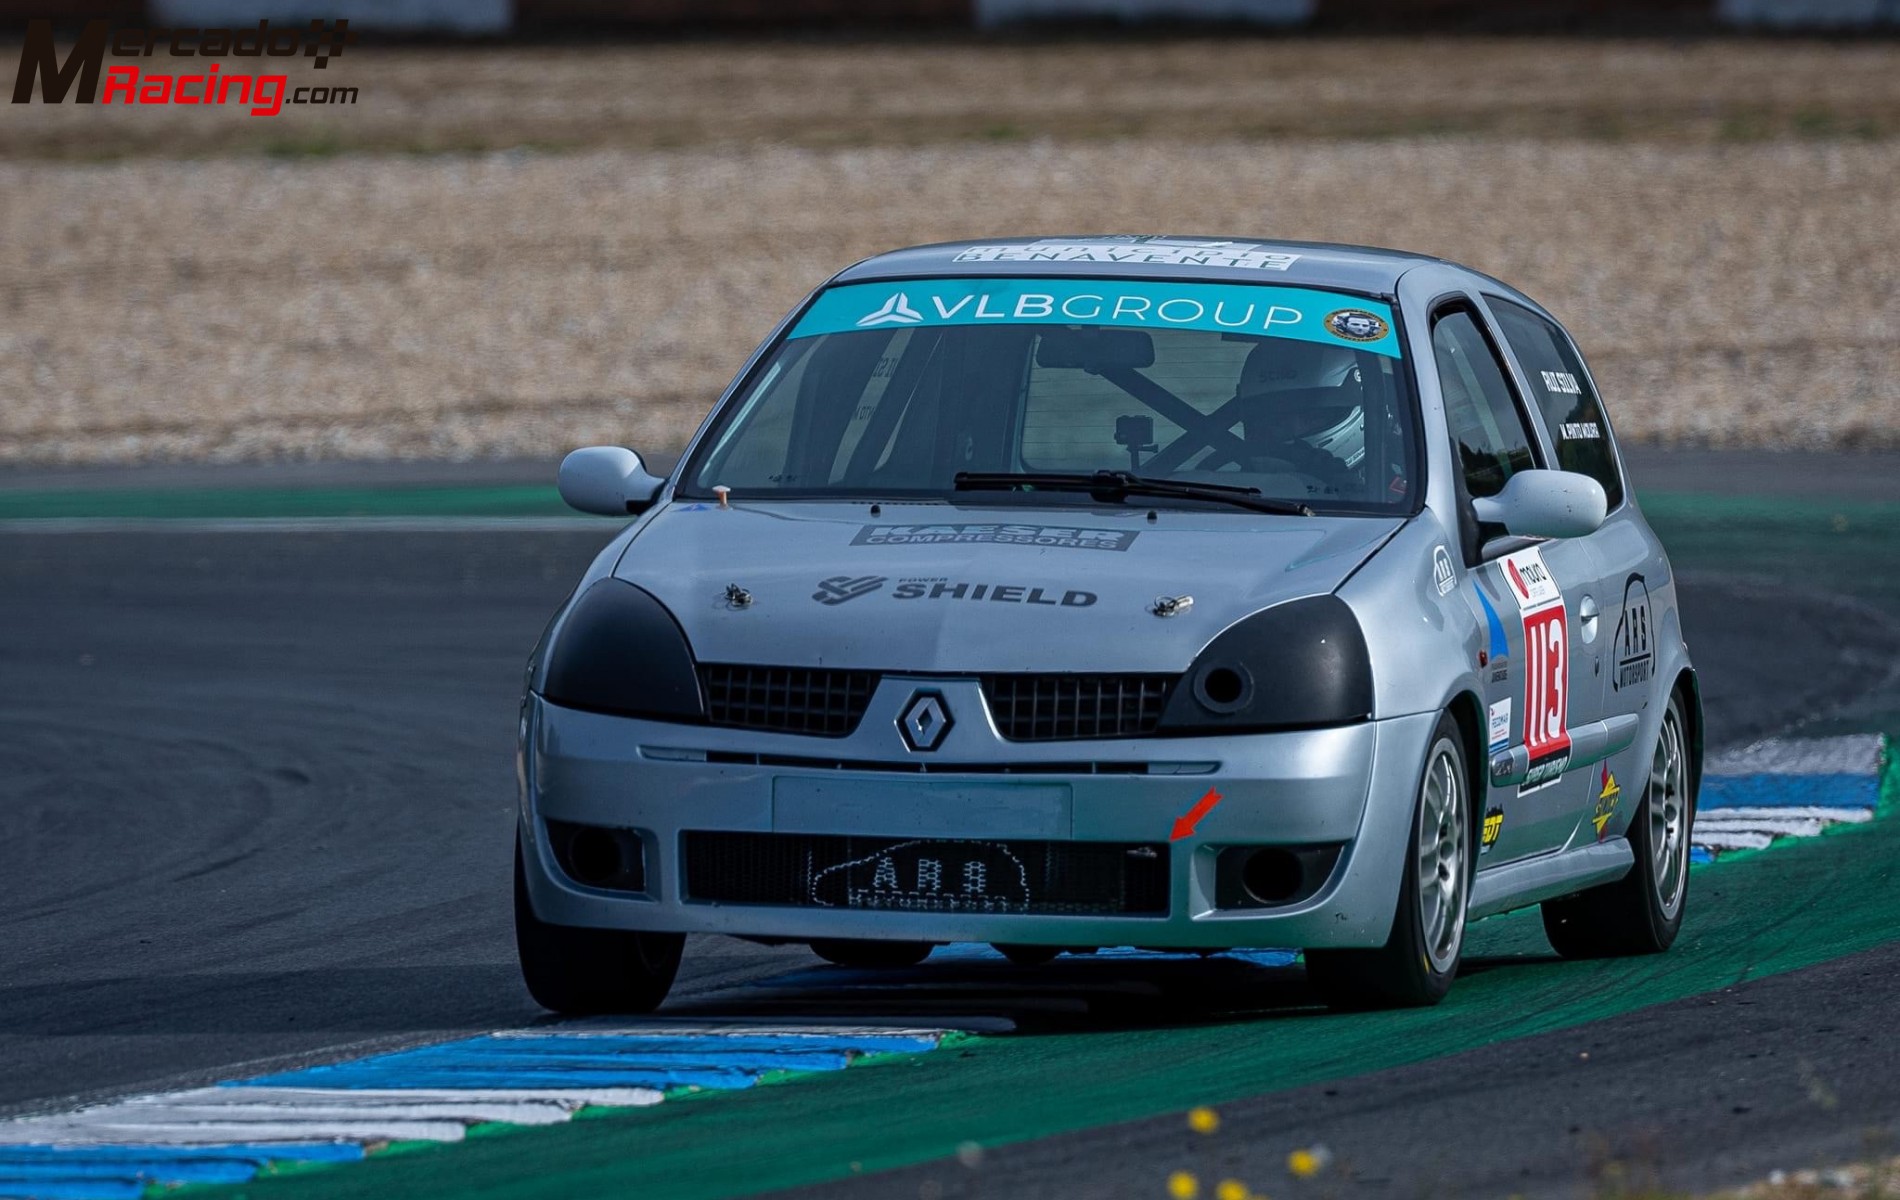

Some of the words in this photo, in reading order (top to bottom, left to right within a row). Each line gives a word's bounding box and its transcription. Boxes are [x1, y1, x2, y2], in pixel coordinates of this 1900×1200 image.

[957, 252, 1287, 270] BENAVENTE
[865, 534, 1118, 549] COMPRESSORES
[870, 525, 1125, 541] KAESER
[892, 583, 1097, 608] SHIELD
[1530, 618, 1565, 747] 113
